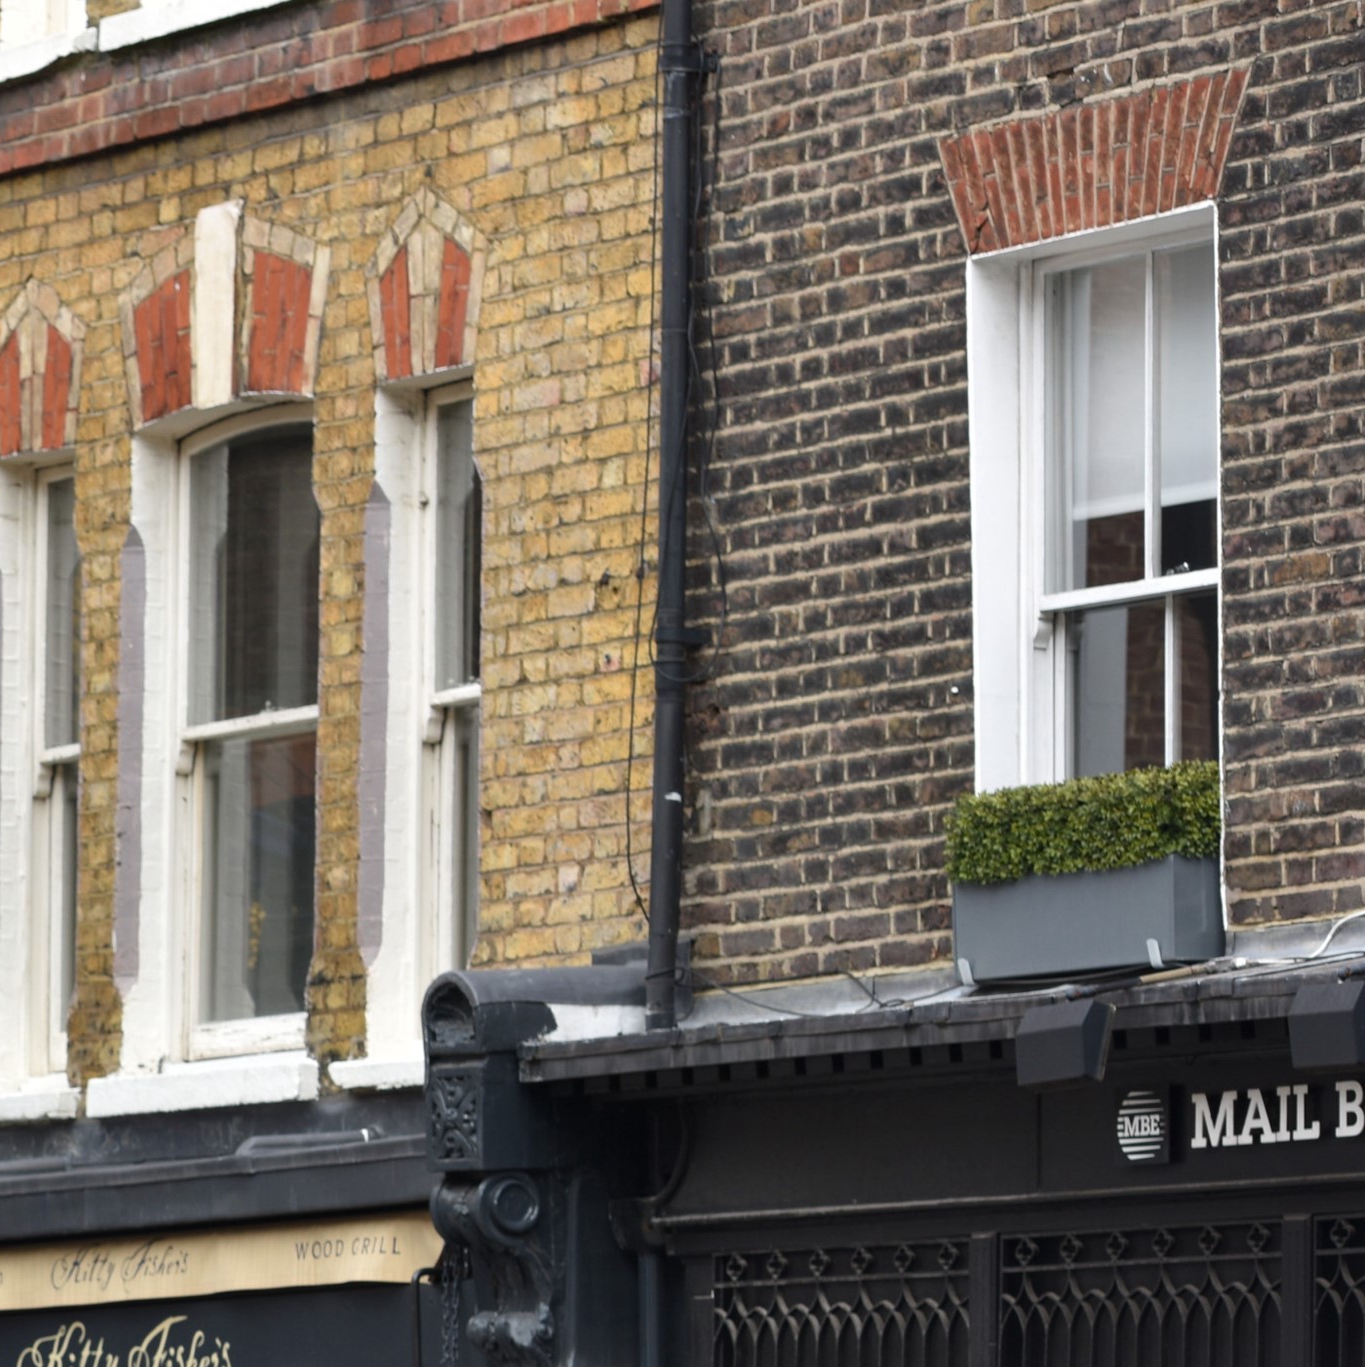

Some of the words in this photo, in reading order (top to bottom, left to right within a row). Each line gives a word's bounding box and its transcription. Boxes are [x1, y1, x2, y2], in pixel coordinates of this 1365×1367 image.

[1124, 1114, 1160, 1137] MBE
[1191, 1083, 1320, 1148] MAIL
[51, 1243, 116, 1291] Kitty
[295, 1239, 344, 1260] WOOD
